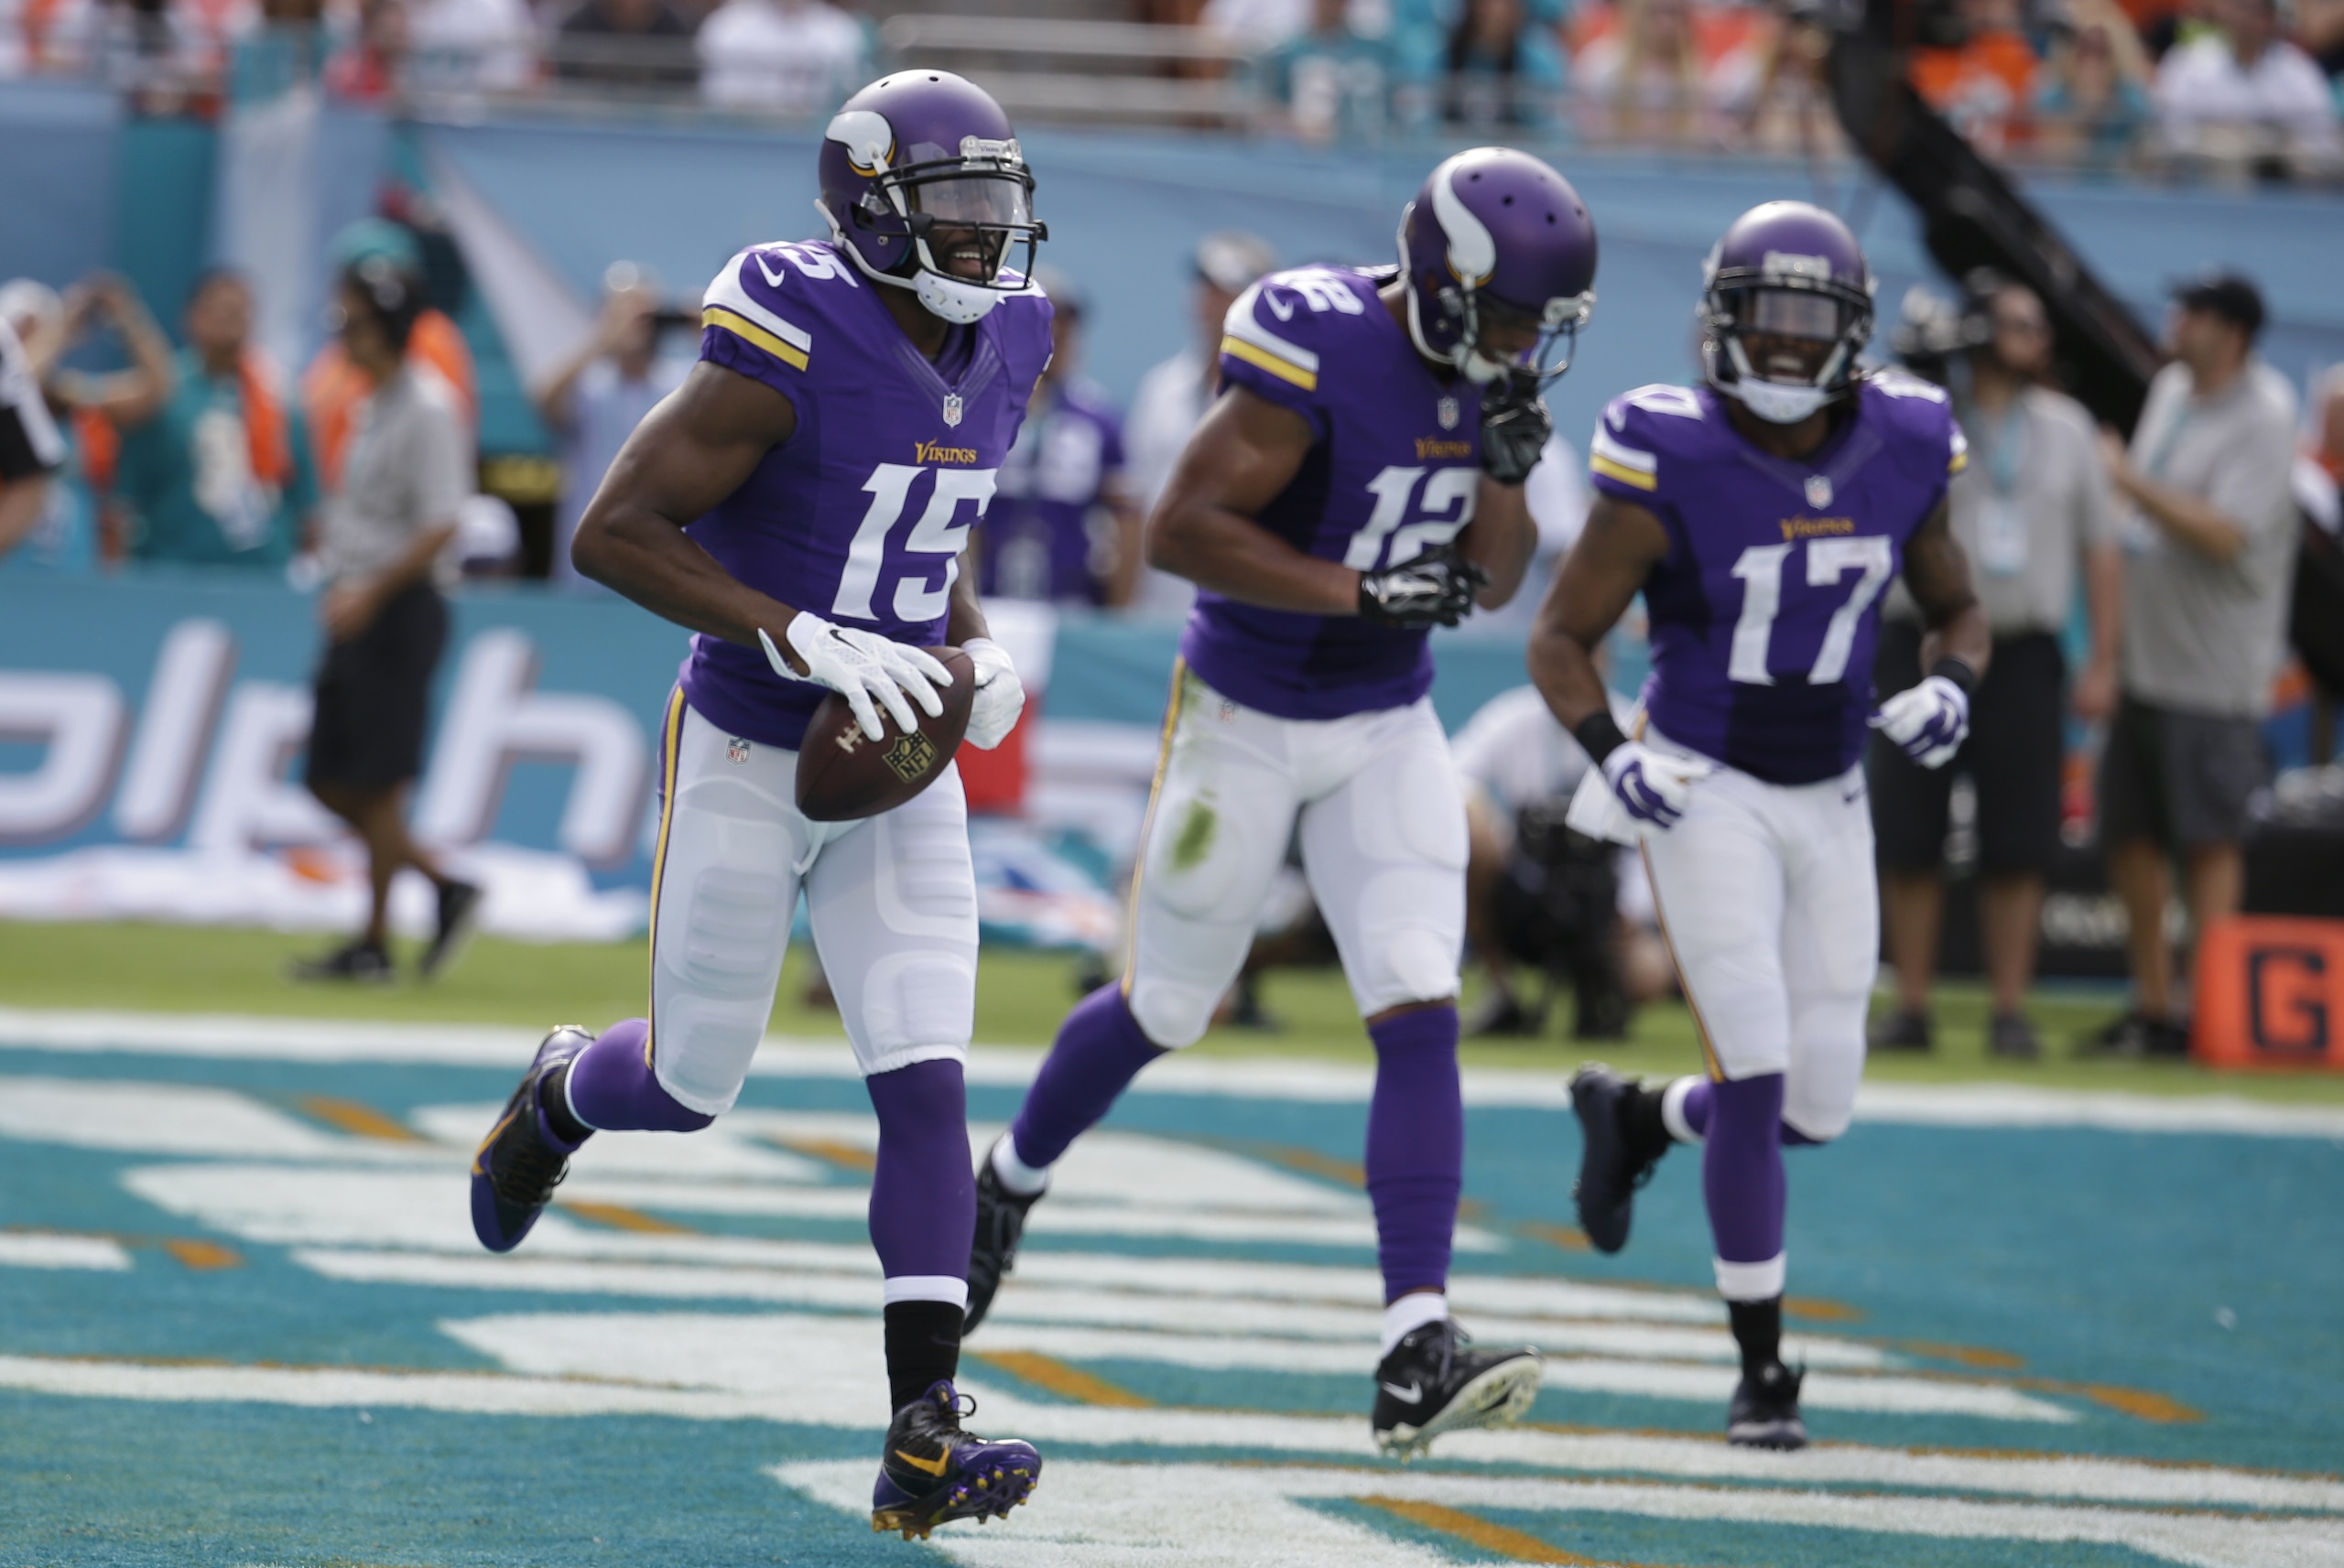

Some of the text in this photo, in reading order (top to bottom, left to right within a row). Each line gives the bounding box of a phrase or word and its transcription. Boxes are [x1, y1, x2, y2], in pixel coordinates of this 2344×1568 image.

[831, 462, 997, 622] 15
[1342, 465, 1481, 572] 12
[1727, 534, 1893, 686] 17
[898, 742, 934, 778] NFL
[2248, 943, 2328, 1054] G
